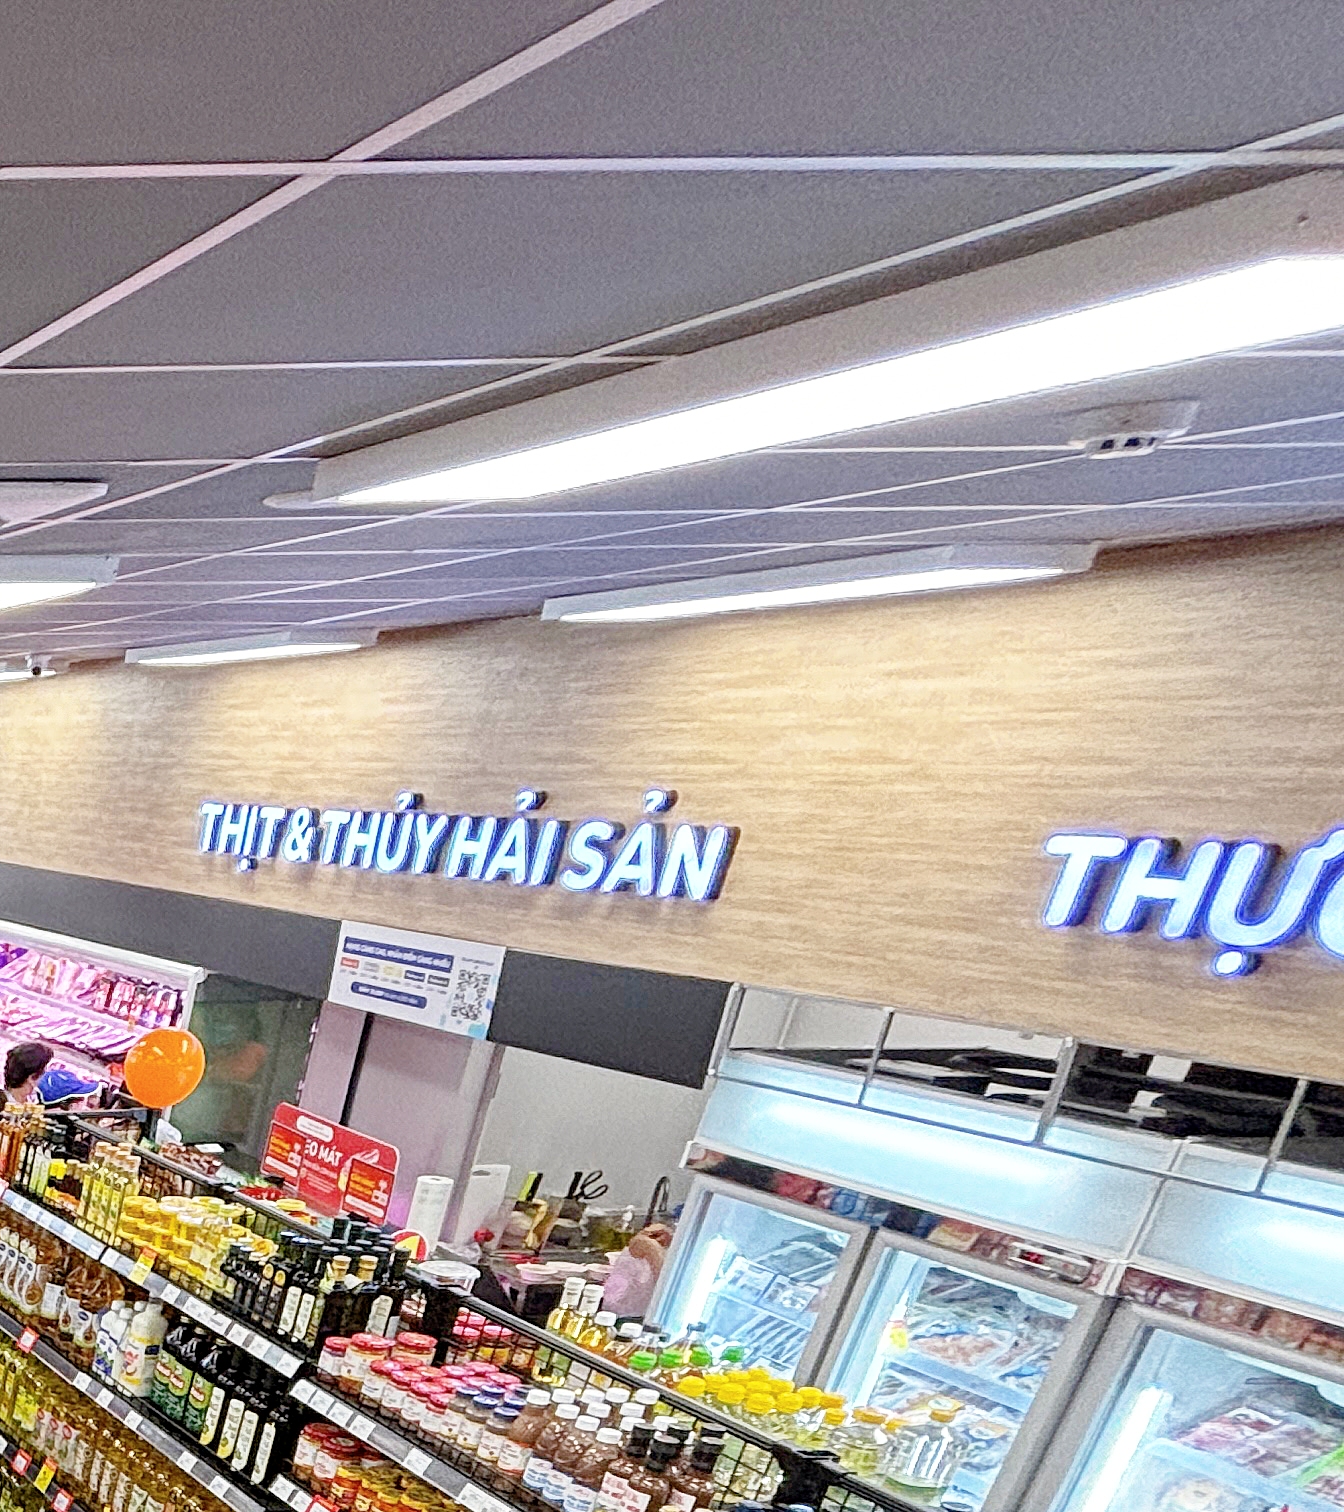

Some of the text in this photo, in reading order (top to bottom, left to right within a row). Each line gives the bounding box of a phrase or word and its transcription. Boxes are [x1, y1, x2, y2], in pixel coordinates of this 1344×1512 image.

[198, 787, 729, 901] THỊT & THỦY HẢI SẢN
